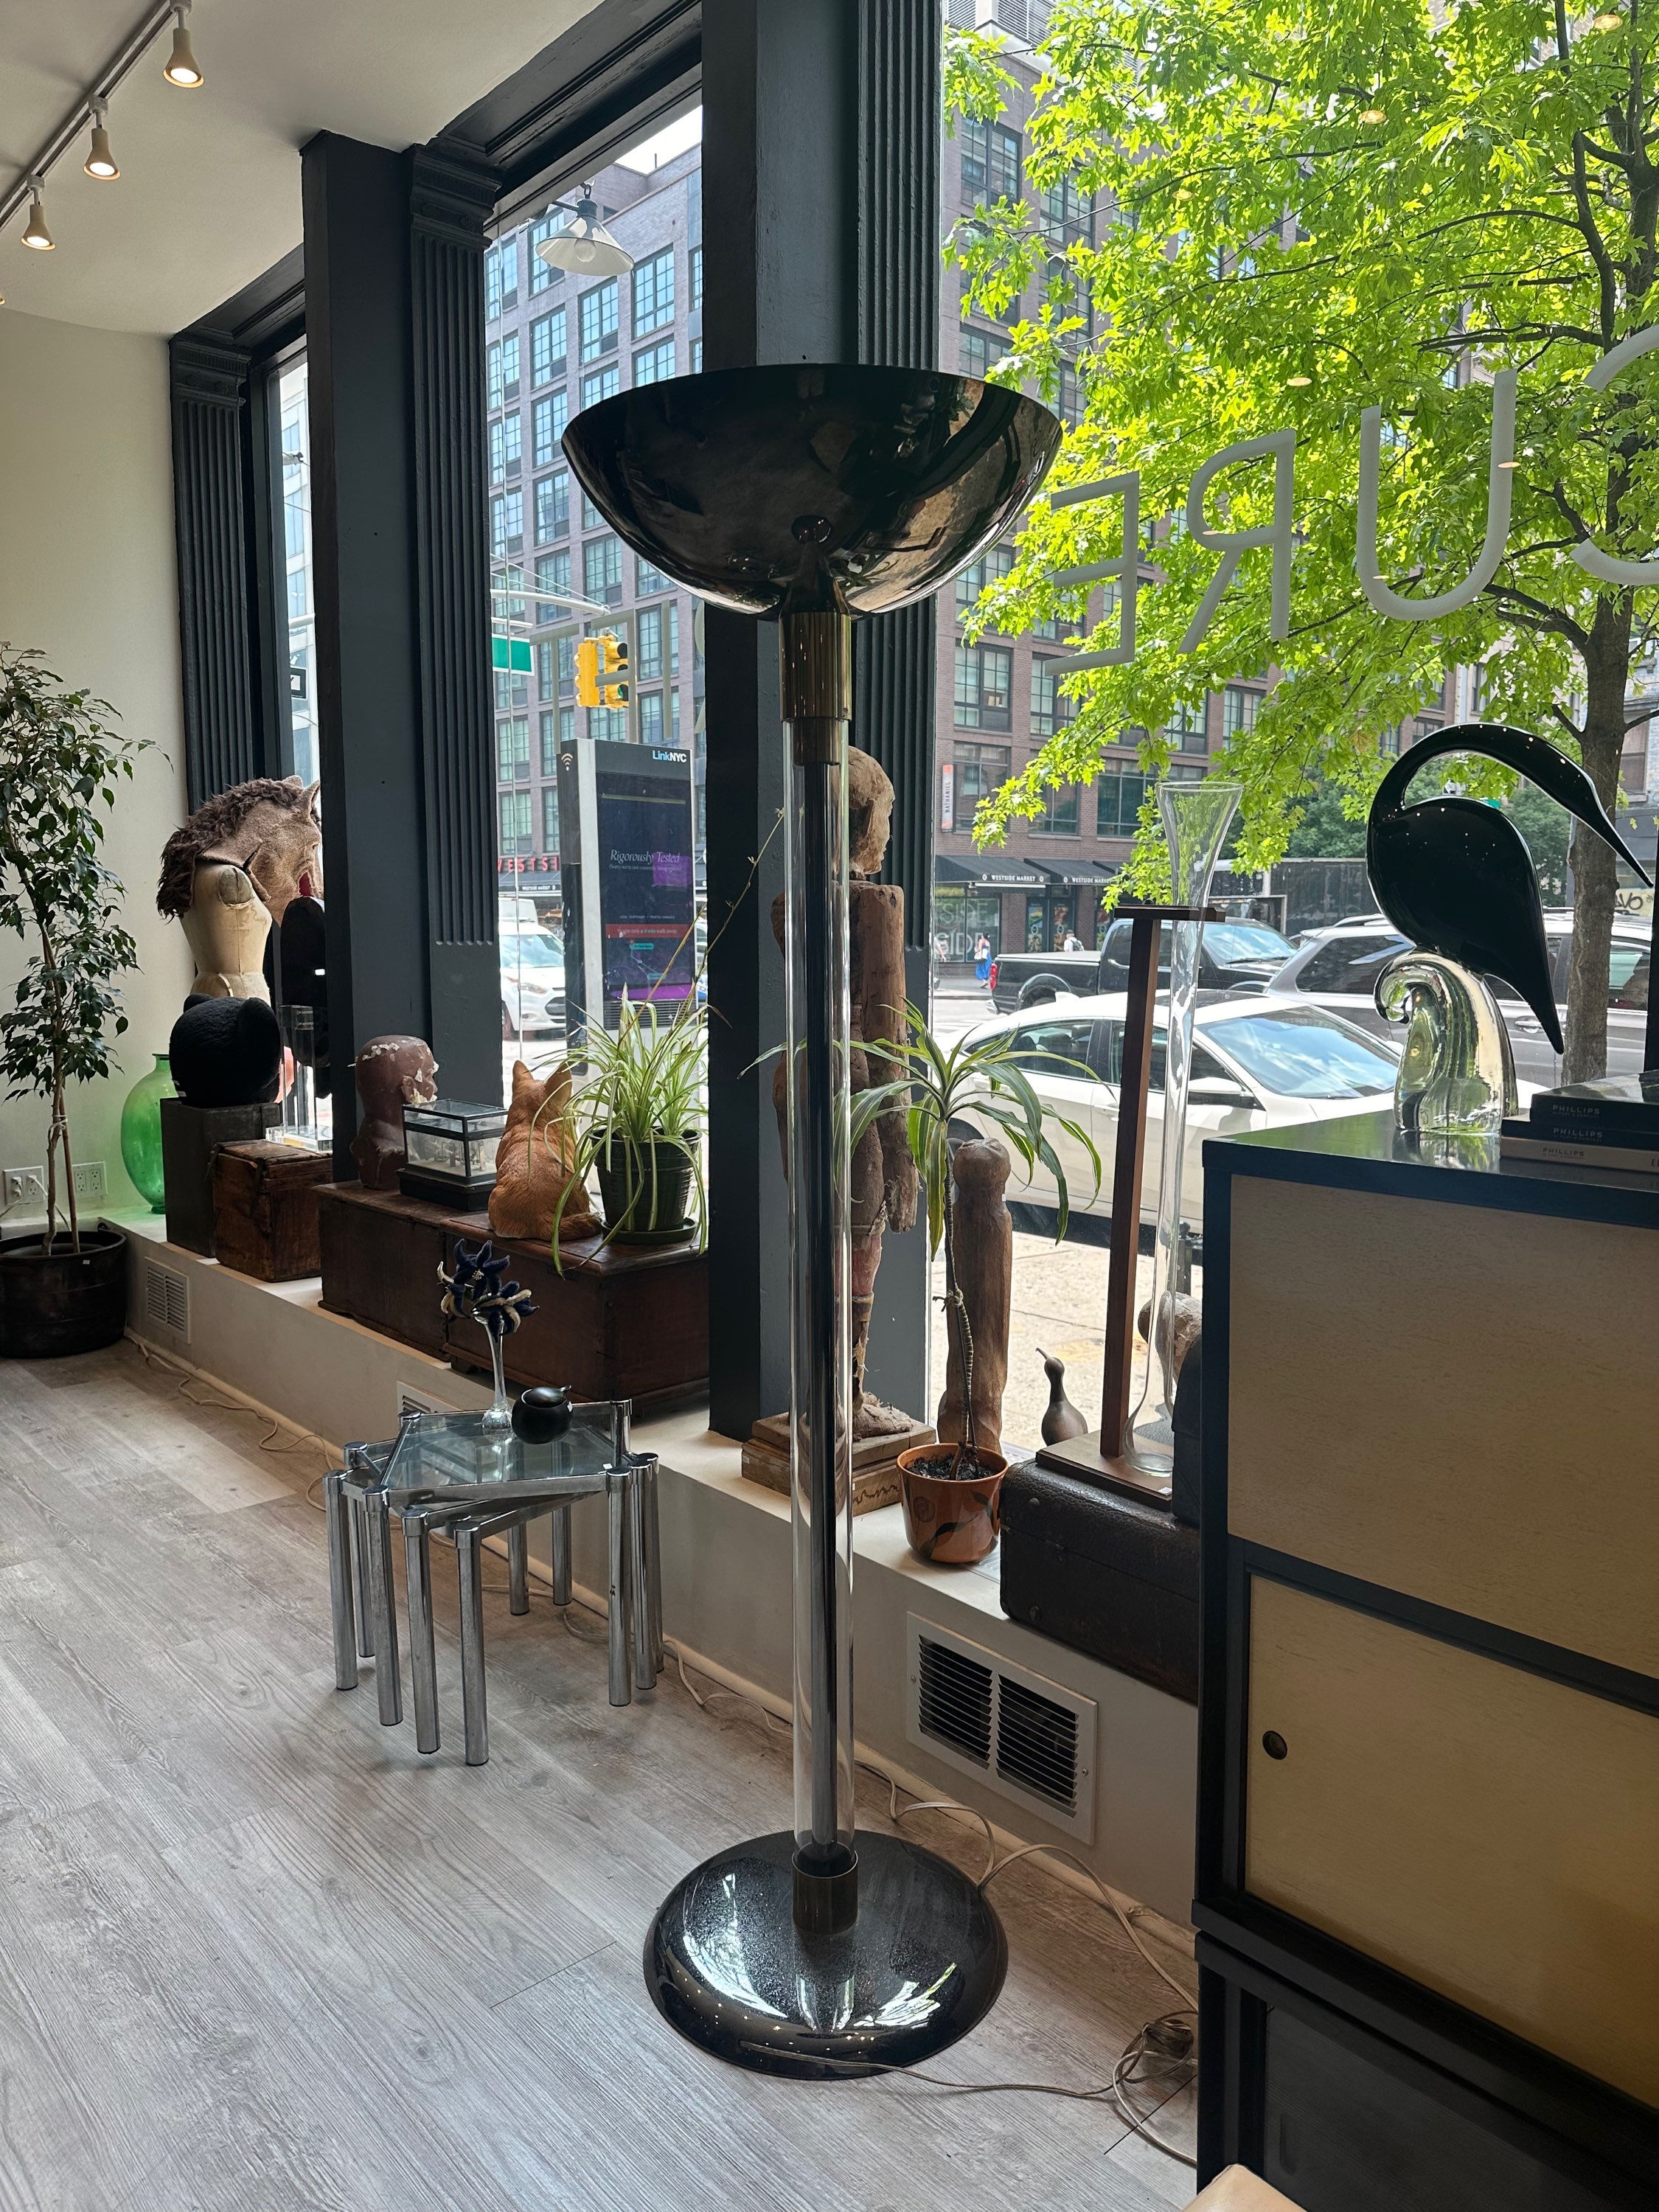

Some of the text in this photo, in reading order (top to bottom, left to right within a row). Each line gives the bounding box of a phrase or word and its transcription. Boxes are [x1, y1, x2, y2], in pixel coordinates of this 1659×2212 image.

[652, 750, 687, 763] LinkNYC
[610, 849, 681, 866] Rigorously Tested
[1552, 1104, 1600, 1115] PHILLIPS
[1553, 1127, 1603, 1138] PHILLIPS
[1543, 1147, 1585, 1157] PHILLIPS
